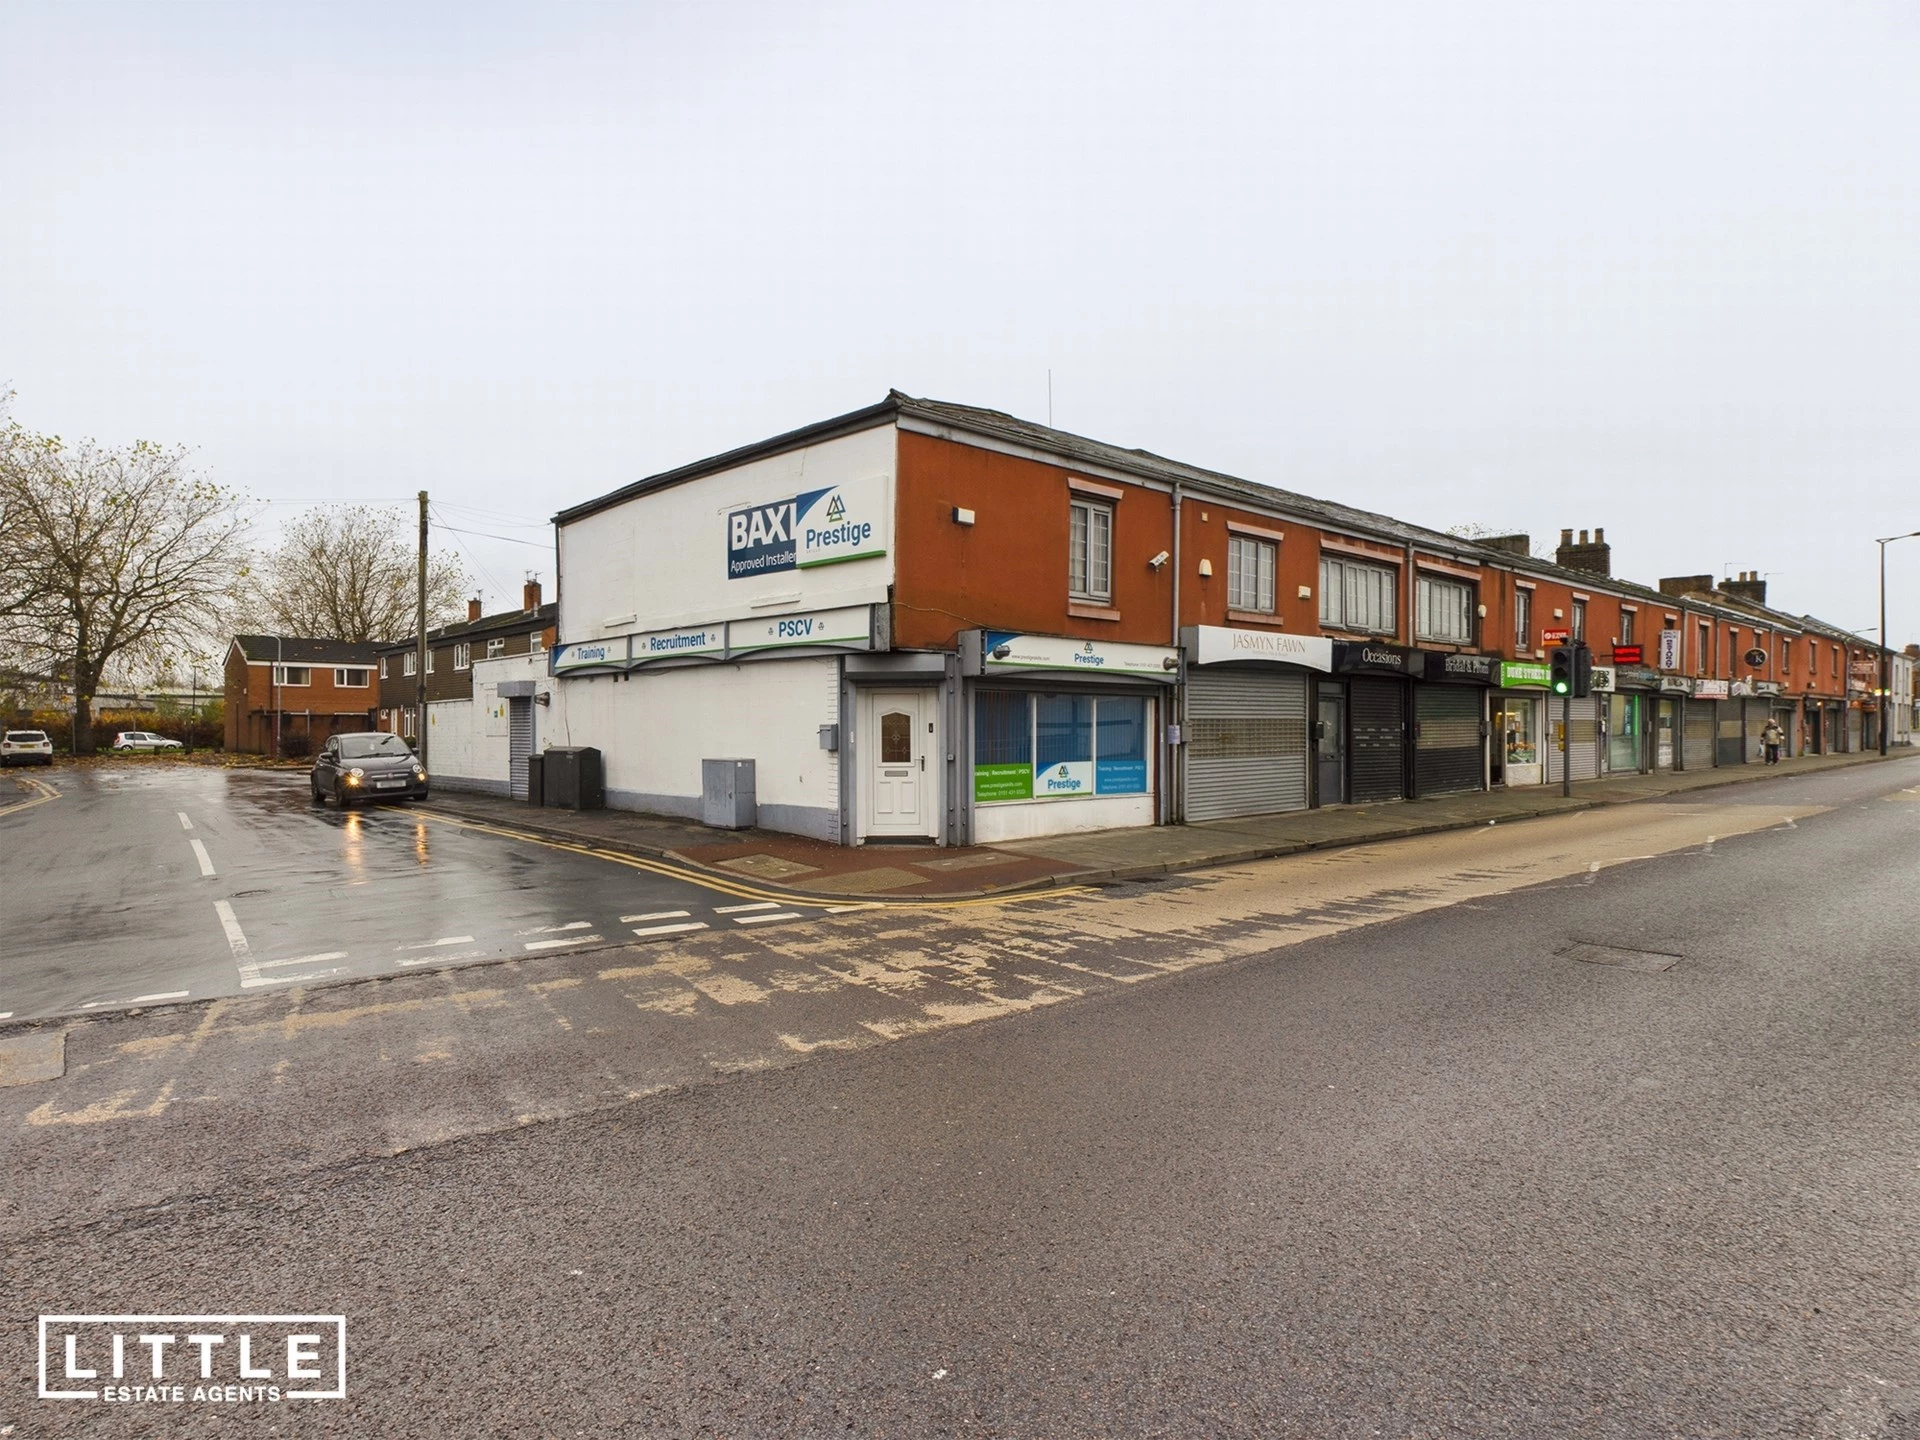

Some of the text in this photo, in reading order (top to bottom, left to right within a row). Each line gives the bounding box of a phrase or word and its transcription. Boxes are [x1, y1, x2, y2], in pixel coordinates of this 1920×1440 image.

[731, 502, 797, 551] BAXI
[806, 520, 871, 549] Prestige
[731, 554, 765, 574] Approved
[766, 551, 797, 567] Installer
[779, 618, 813, 638] PSCV
[650, 631, 706, 651] Recruitment
[1232, 633, 1306, 653] JASMYN FAWN
[577, 645, 605, 660] Training
[1074, 653, 1104, 667] Prestige
[1362, 647, 1401, 665] Occasions
[1445, 657, 1489, 674] Bridal & Prom
[1047, 778, 1081, 791] Prestige
